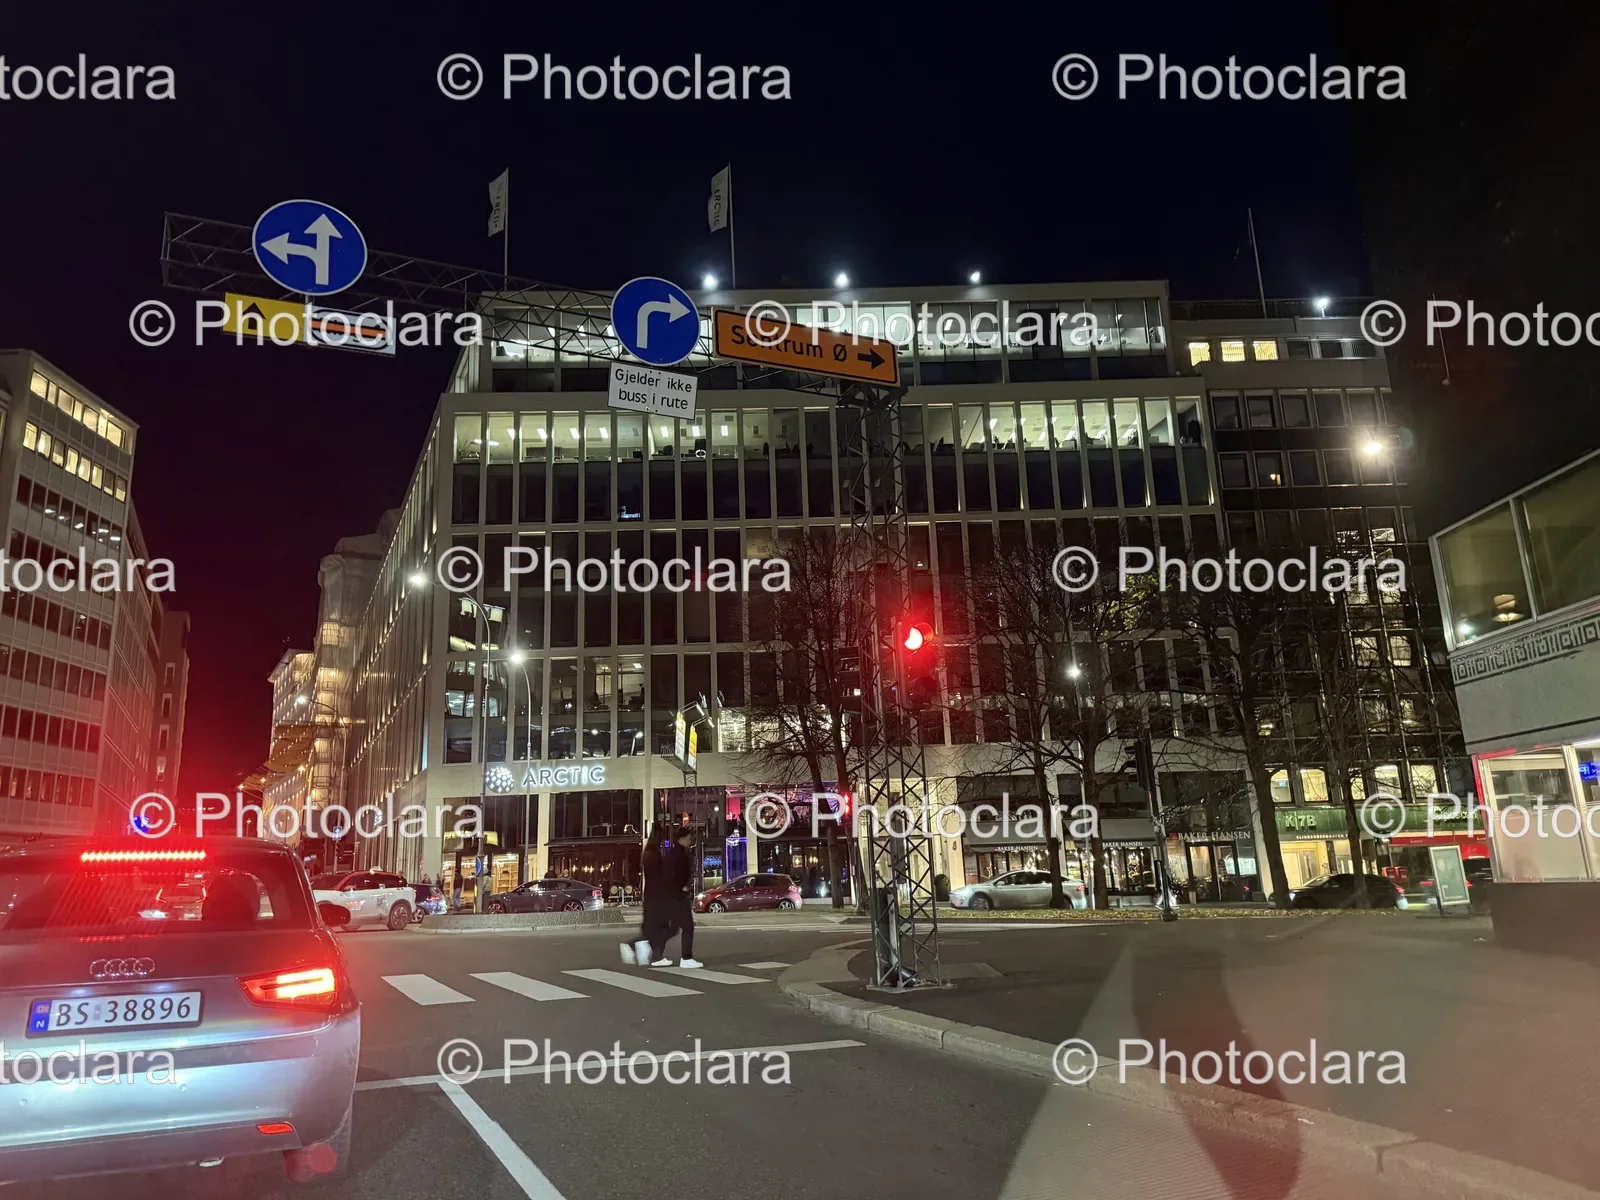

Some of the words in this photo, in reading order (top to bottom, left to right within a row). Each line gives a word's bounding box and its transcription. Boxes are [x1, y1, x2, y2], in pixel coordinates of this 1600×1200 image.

[833, 343, 848, 362] Ø
[615, 368, 661, 387] Gjelder
[667, 377, 692, 393] ikke
[618, 388, 648, 404] buss
[652, 393, 656, 405] i
[661, 396, 689, 410] rute
[522, 765, 605, 787] ARCTIC
[1178, 832, 1208, 840] BAKER
[1211, 831, 1251, 840] HANSEN
[56, 1002, 89, 1027] BS
[105, 997, 191, 1023] 38896
